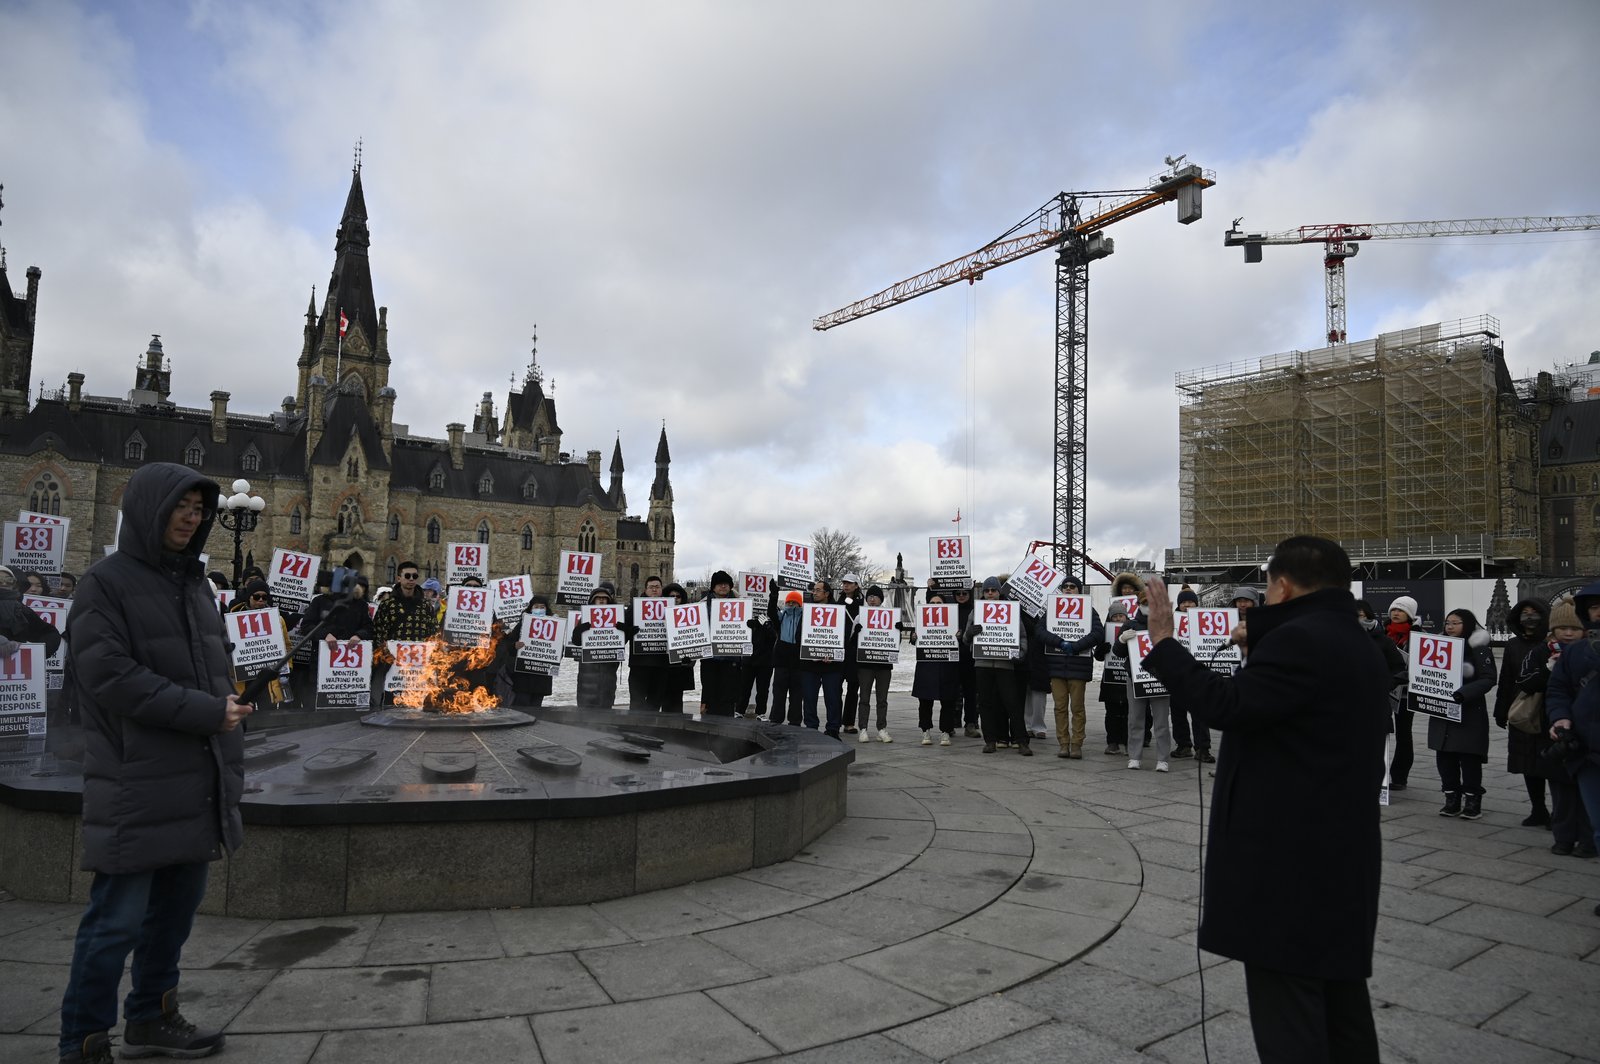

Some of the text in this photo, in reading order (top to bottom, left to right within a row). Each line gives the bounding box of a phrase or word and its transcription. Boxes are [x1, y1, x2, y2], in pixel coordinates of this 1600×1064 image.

[19, 527, 49, 550] 38
[458, 548, 477, 565] 43
[788, 546, 805, 563] 41
[940, 540, 959, 558] 33
[283, 555, 308, 576] 27
[571, 555, 590, 574] 17
[1028, 563, 1053, 584] 20
[274, 582, 296, 590] WAITING
[280, 577, 303, 585] MONTHS
[502, 580, 522, 598] 35
[748, 576, 764, 592] 28
[1017, 577, 1034, 591] WAITING
[1024, 576, 1042, 590] MONTHS
[282, 590, 309, 598] RESPONSE
[460, 591, 483, 611] 33
[1020, 587, 1042, 603] RESPONSE
[645, 601, 665, 619] 30
[677, 607, 697, 626] 20
[722, 602, 741, 621] 31
[814, 607, 834, 626] 37
[926, 608, 944, 626] 11
[986, 604, 1008, 623] 23
[1059, 599, 1080, 618] 22
[242, 614, 267, 637] 11
[594, 609, 614, 628] 32
[870, 610, 890, 629] 40
[1202, 612, 1226, 635] 39
[533, 620, 554, 640] 90
[239, 646, 265, 655] WAITING
[245, 639, 270, 647] MONTHS
[683, 638, 708, 646] RESPONSE
[252, 650, 282, 661] RESPONSE
[333, 645, 360, 667] 25
[400, 645, 423, 666] 33
[532, 652, 558, 660] RESPONSE
[1422, 639, 1448, 668] 25
[1415, 676, 1439, 686] WAITING
[1422, 669, 1447, 679] MONTHS
[1411, 683, 1424, 691] IRCC
[1427, 704, 1447, 714] RESULTS
